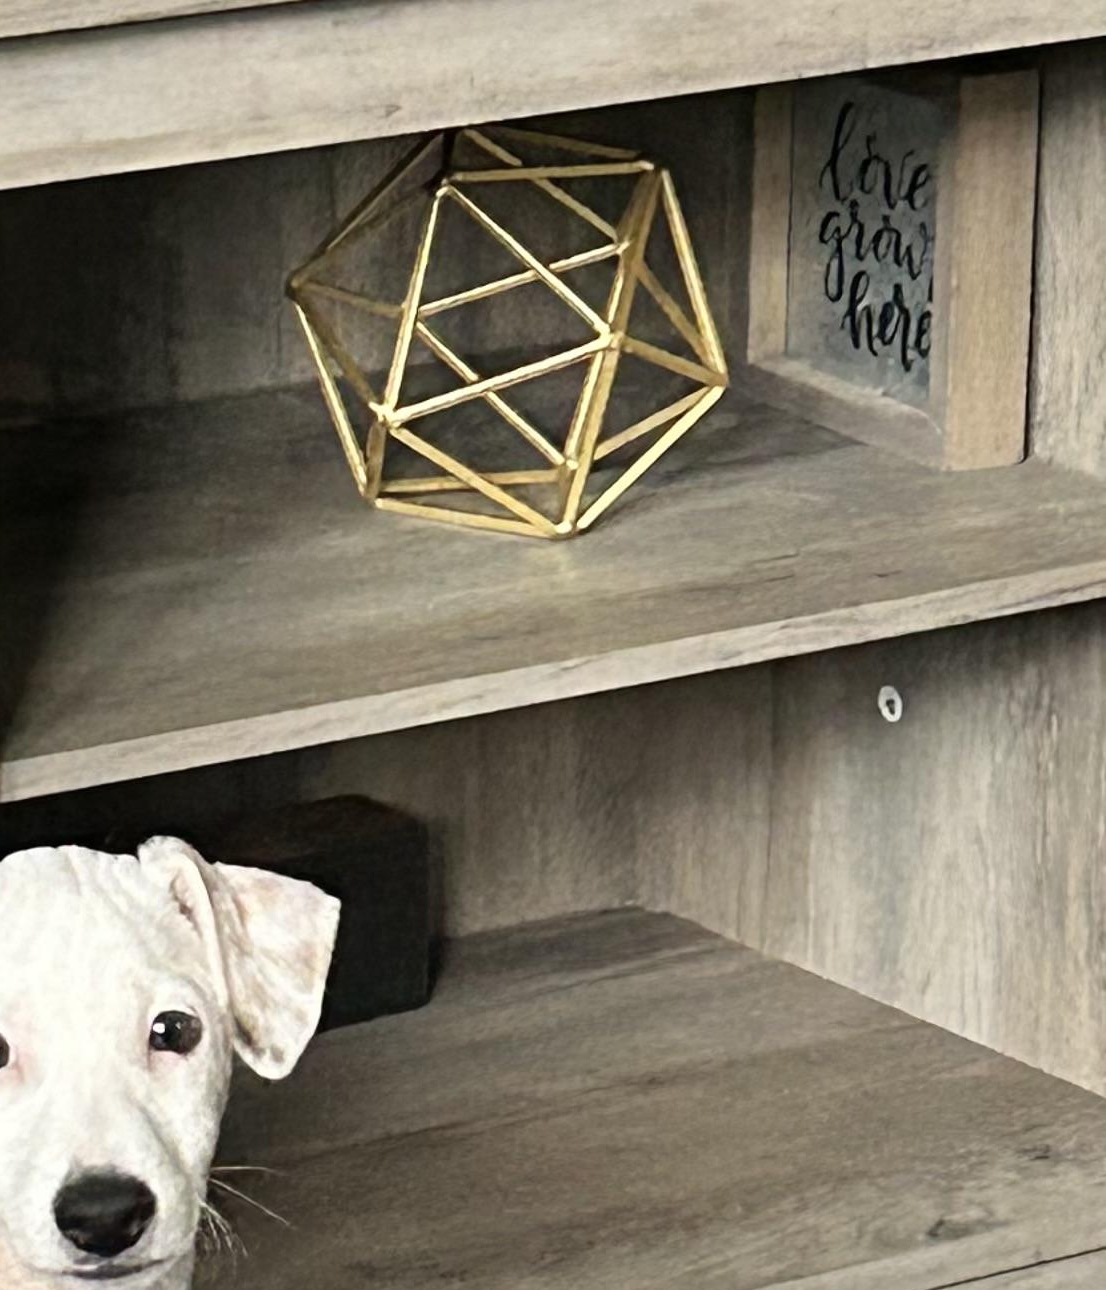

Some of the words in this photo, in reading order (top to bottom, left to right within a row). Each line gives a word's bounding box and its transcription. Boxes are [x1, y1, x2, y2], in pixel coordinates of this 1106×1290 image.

[819, 101, 931, 210] love
[818, 200, 933, 303] grow
[842, 270, 932, 372] here
